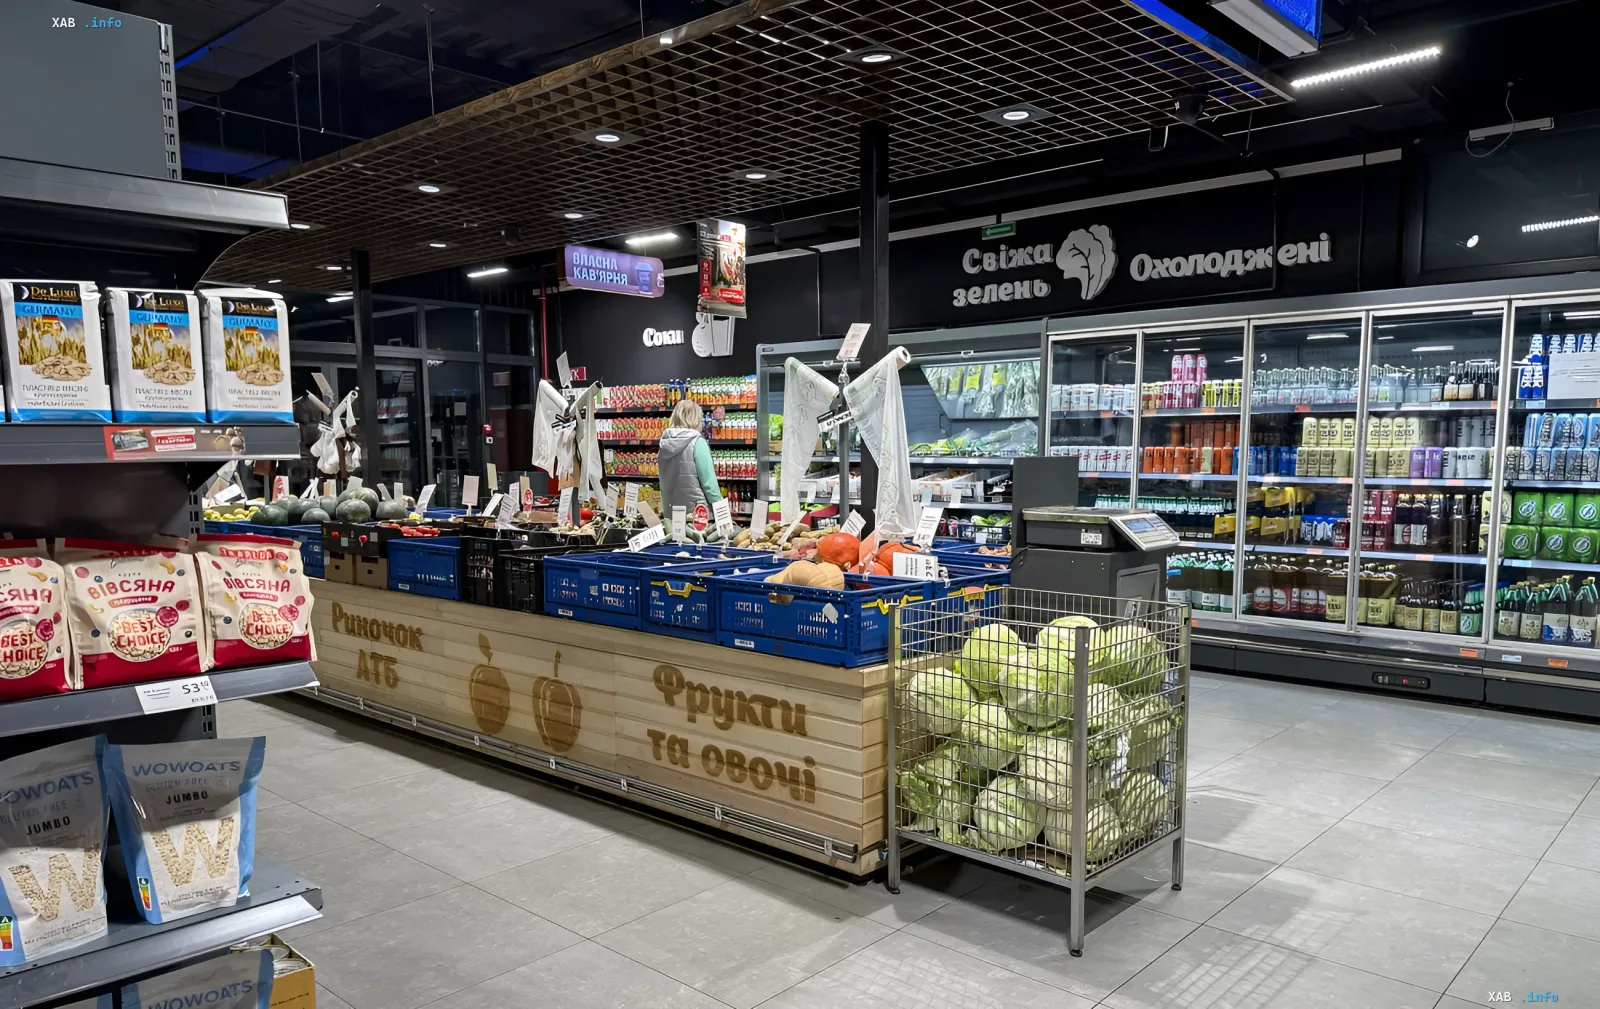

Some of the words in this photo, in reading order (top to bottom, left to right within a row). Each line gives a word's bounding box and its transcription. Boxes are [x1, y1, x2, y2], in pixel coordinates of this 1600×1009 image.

[961, 243, 1054, 274] Свіжа
[1129, 232, 1332, 282] Охолоджені
[951, 276, 1051, 308] зелень
[642, 327, 685, 348] Соки
[87, 578, 175, 599] ВІВСЯНА
[223, 577, 291, 592] ВІВСЯНА
[121, 619, 155, 633] BEST
[246, 623, 289, 636] CHOICE
[331, 601, 424, 652] Риночок
[1, 633, 36, 648] BEST
[116, 631, 166, 648] CHOICE
[0, 646, 46, 662] HOICE
[356, 649, 399, 689] АТБ
[652, 664, 807, 736] Фрукти
[132, 761, 240, 777] WOWOATS
[646, 728, 690, 768] та
[701, 743, 817, 804] овочі
[0, 771, 94, 805] OWOATS
[166, 790, 208, 805] JUMBO
[26, 815, 71, 836] JUMBO
